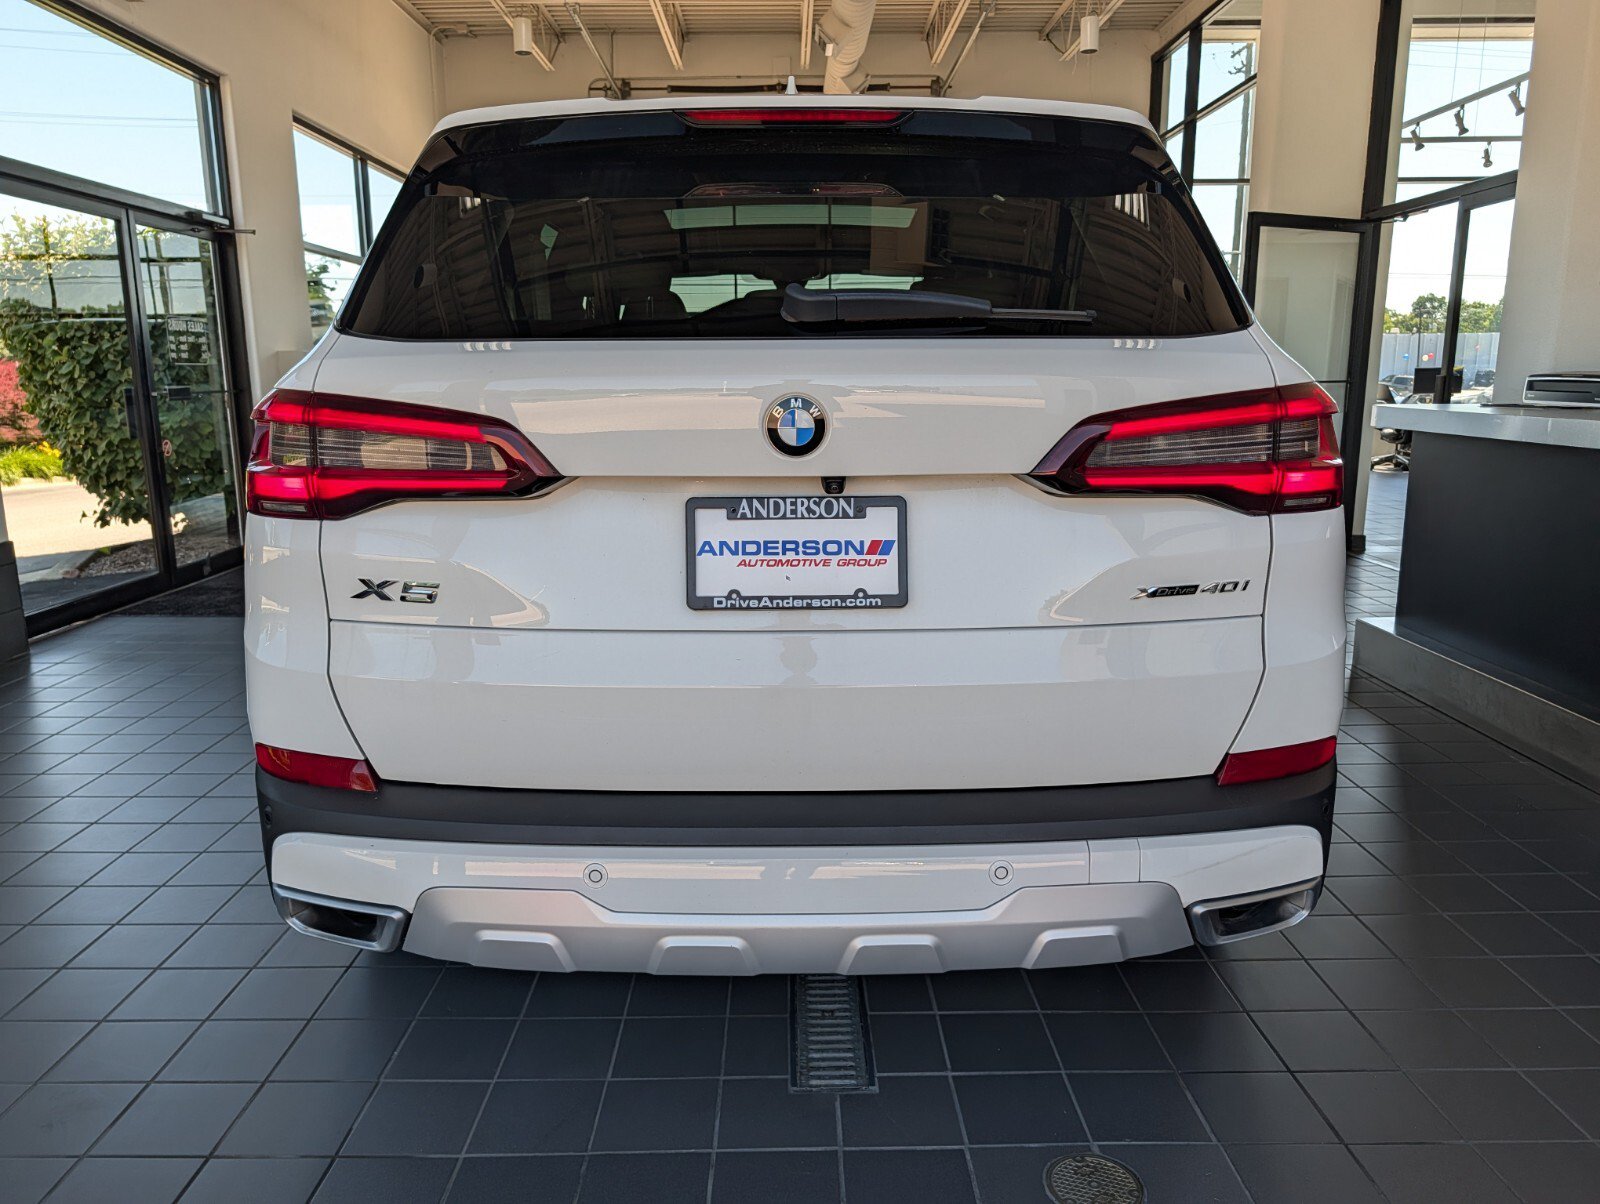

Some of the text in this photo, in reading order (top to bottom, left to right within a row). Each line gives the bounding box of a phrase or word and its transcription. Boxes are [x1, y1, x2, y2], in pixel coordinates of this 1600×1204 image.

[771, 398, 821, 419] BMW
[736, 497, 855, 519] ANDERSON
[695, 539, 865, 557] ANDERSON
[736, 558, 888, 568] AUTOMOTIVE GROUP
[349, 577, 440, 604] X5
[713, 596, 882, 609] DriveAnderson.com
